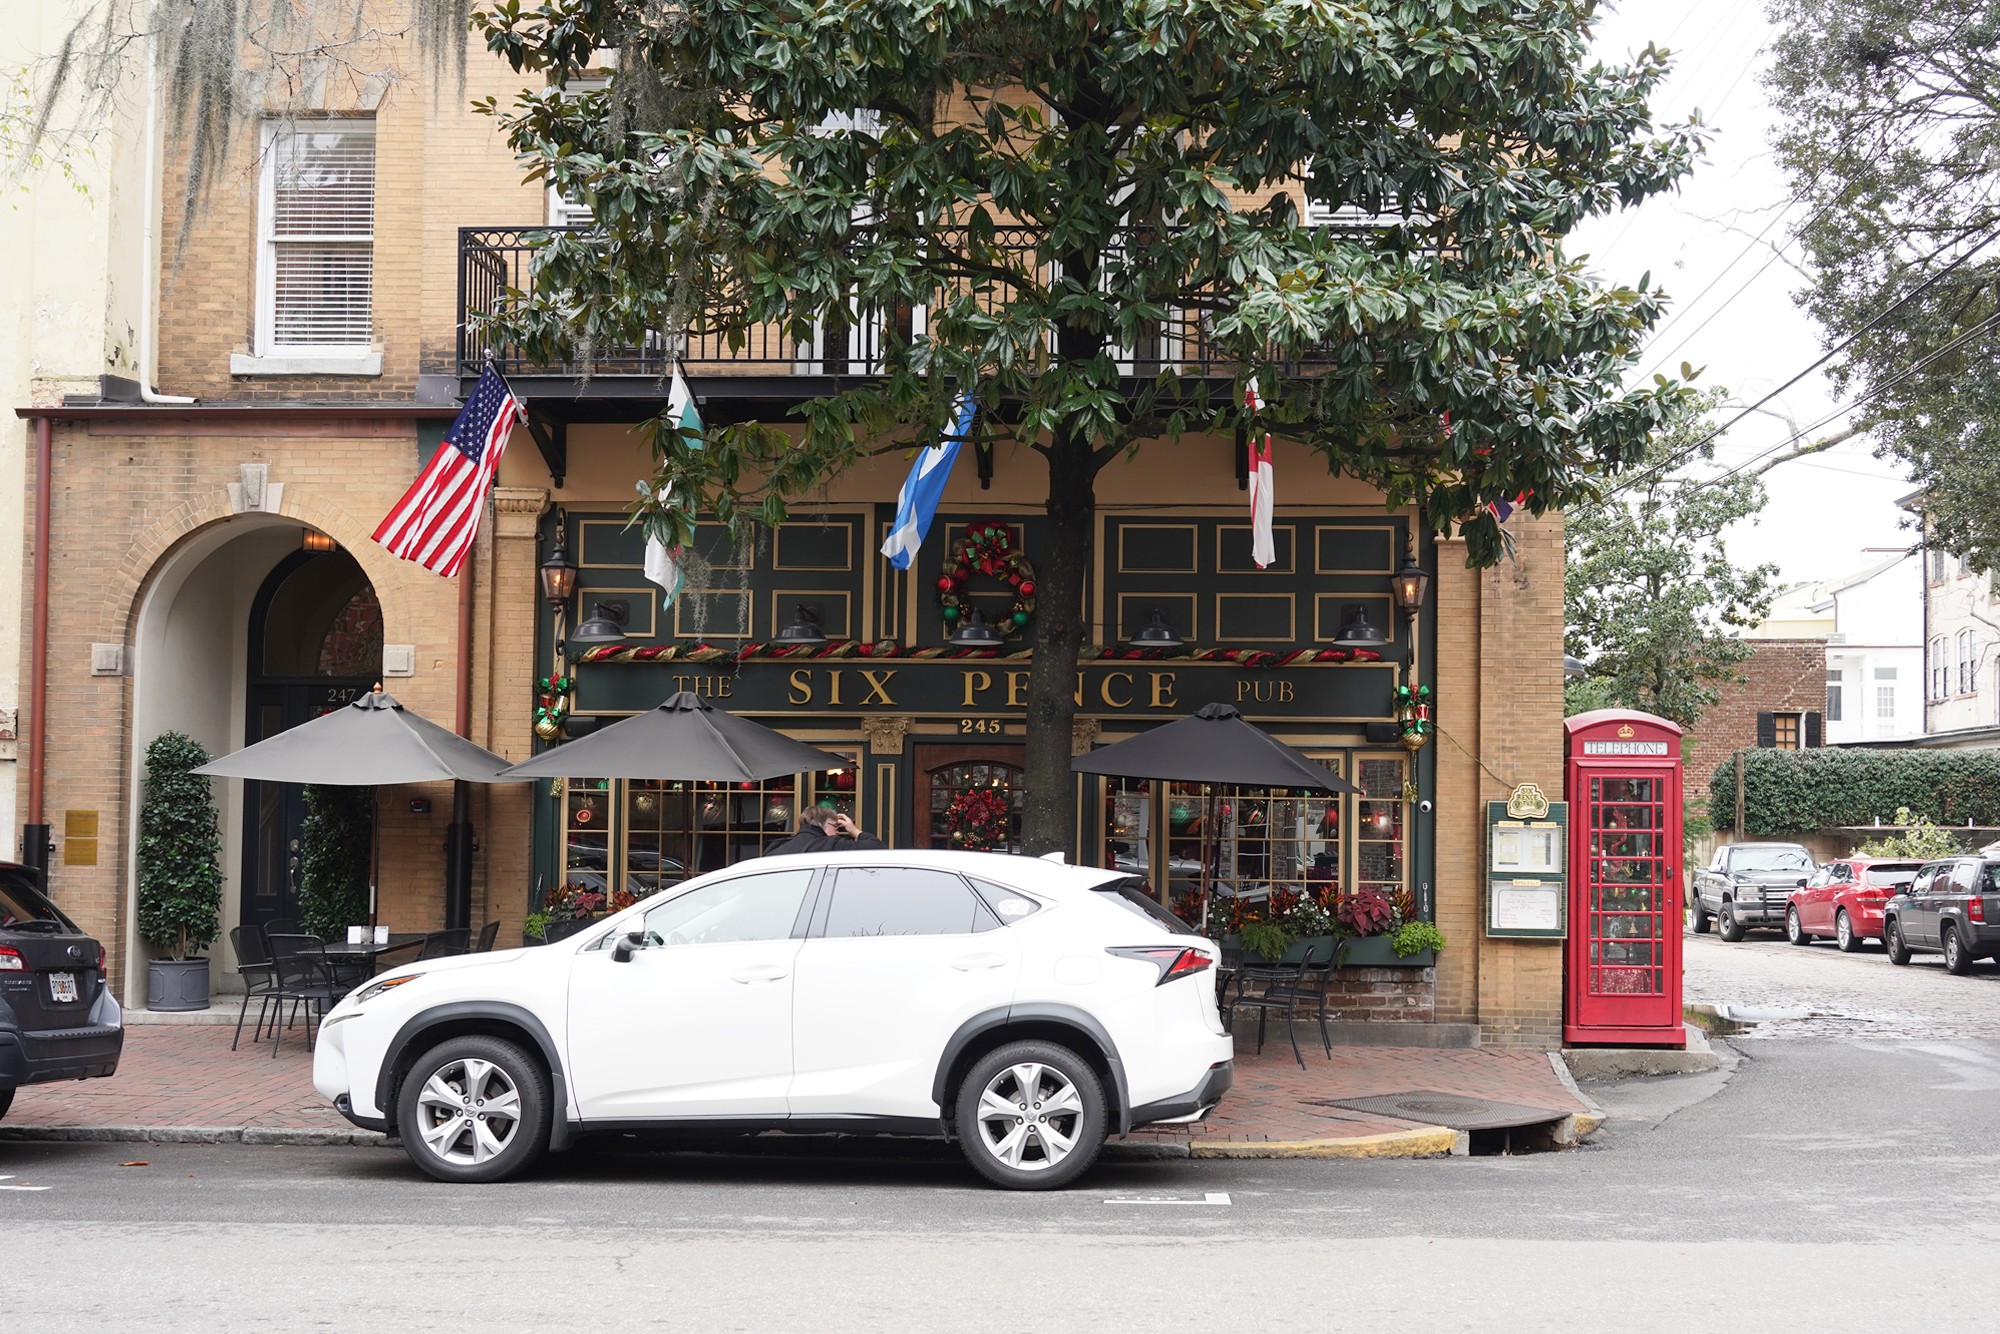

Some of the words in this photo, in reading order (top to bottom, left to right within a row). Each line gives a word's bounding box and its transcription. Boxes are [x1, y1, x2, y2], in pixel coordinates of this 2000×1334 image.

[672, 675, 733, 698] THE
[787, 668, 898, 705] SIX
[1235, 680, 1295, 703] PUB
[327, 688, 357, 702] 247
[961, 718, 1000, 734] 245
[1587, 742, 1664, 754] TELEPHONE
